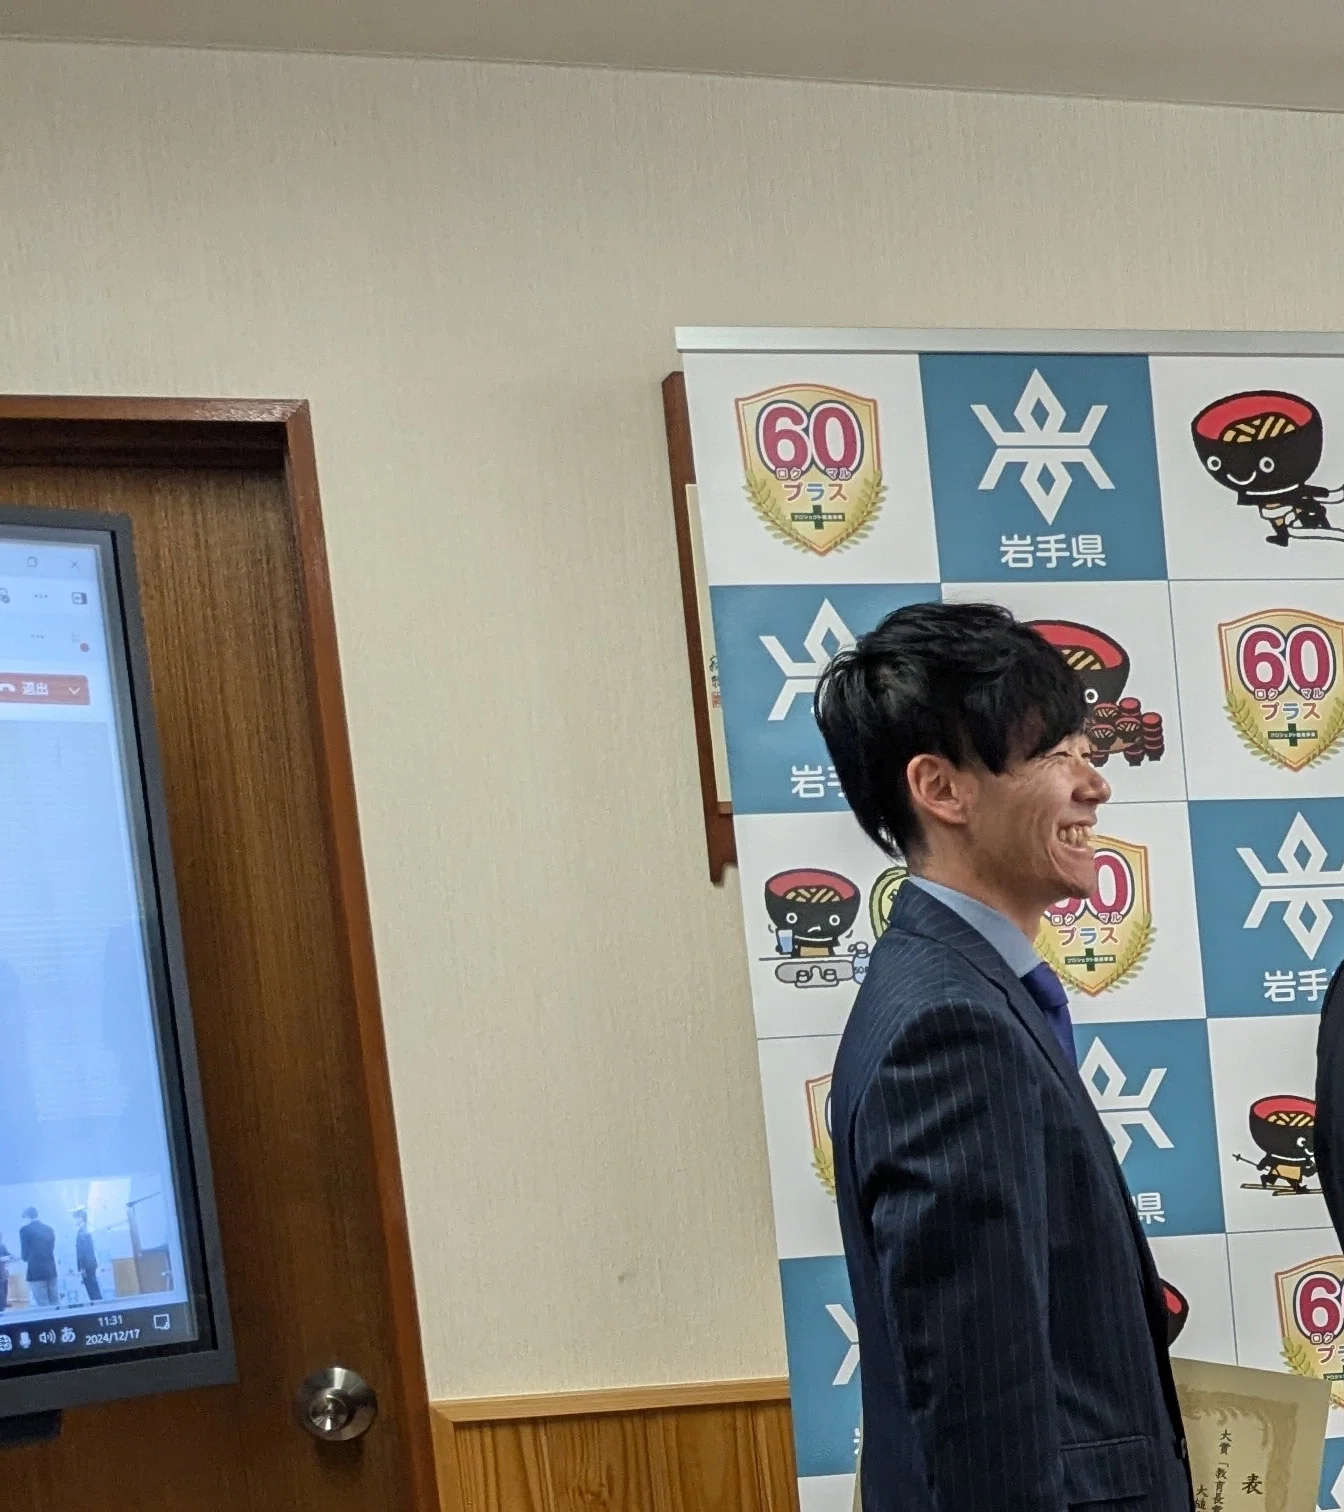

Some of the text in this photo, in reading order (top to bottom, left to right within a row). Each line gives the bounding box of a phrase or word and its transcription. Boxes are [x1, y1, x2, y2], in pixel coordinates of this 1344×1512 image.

[758, 402, 861, 473] 60
[784, 482, 847, 501] プラス
[1000, 534, 1106, 568] 岩手県
[1238, 627, 1332, 694] 60
[1262, 702, 1320, 720] プラス
[1058, 927, 1115, 946] プラス
[1263, 969, 1331, 1002] 岩手
[98, 1314, 123, 1327] 11:31
[61, 1326, 76, 1343] あ
[86, 1328, 140, 1345] 2024/12/17
